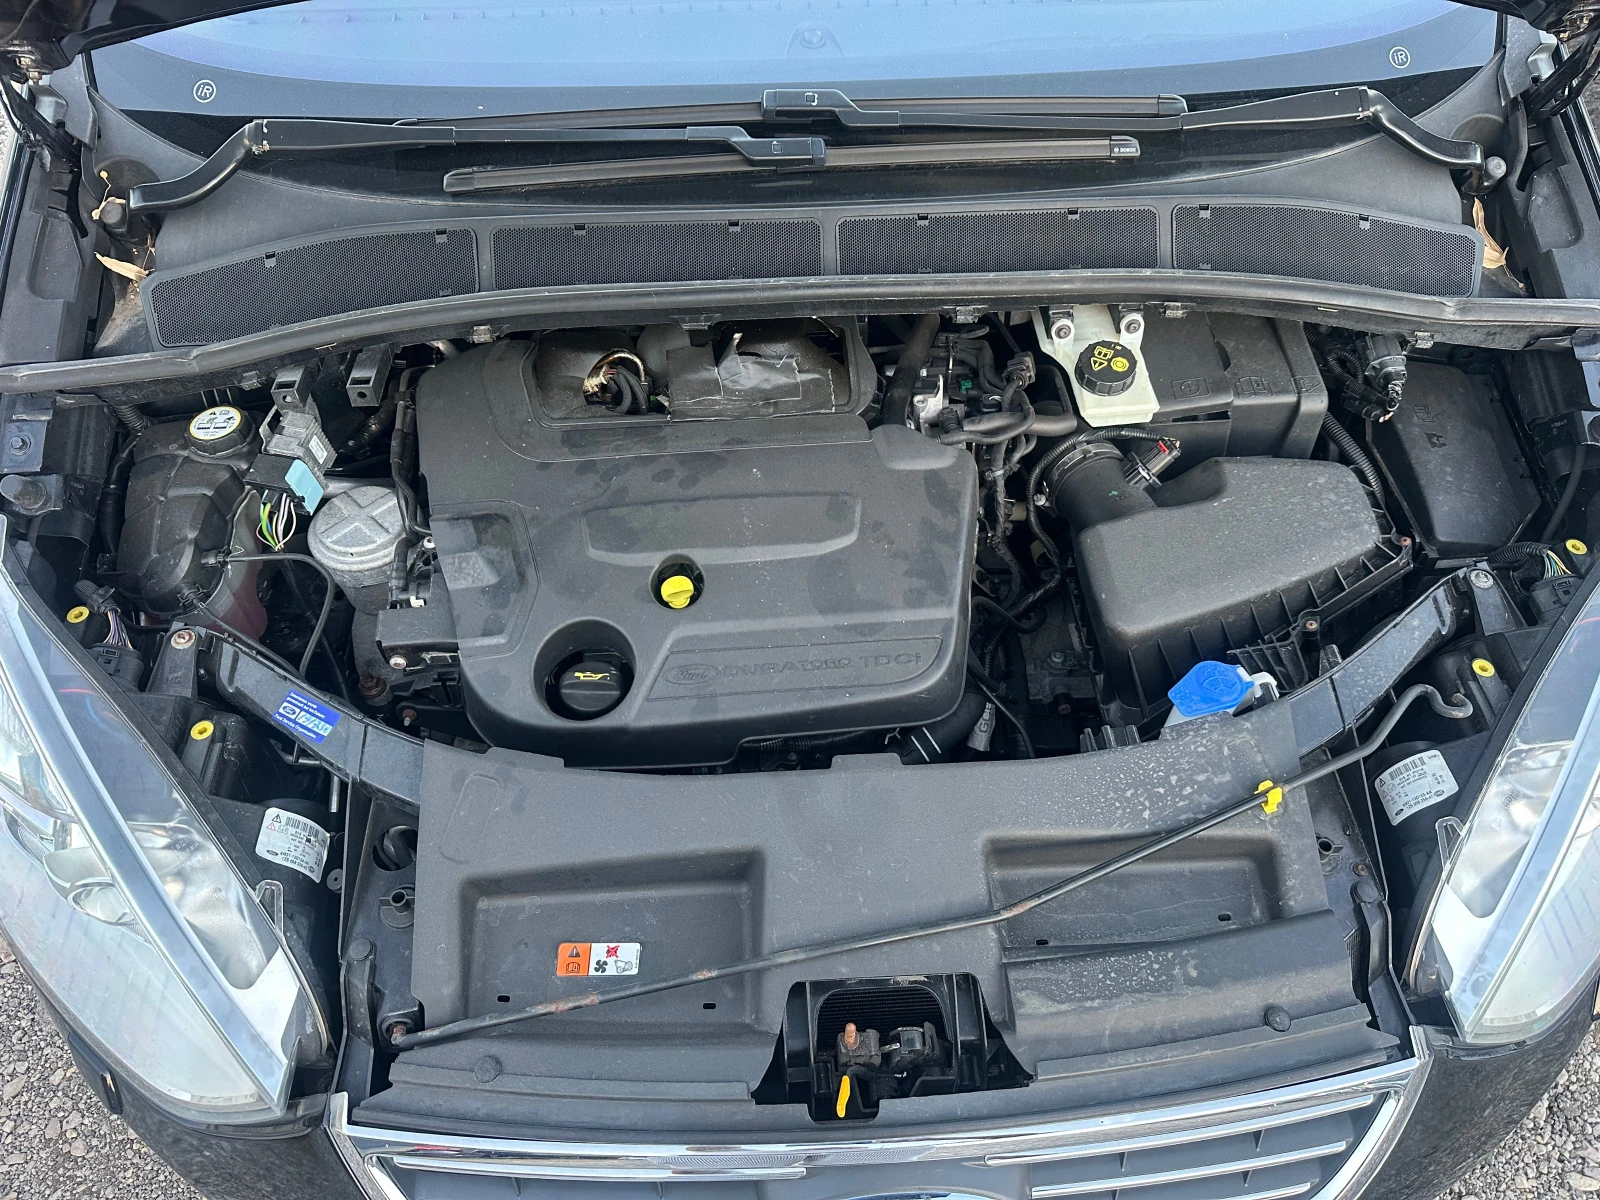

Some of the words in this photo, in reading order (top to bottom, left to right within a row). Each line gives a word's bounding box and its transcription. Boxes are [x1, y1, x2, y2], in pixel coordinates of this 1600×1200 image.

[1393, 51, 1407, 64] iR
[197, 84, 213, 98] iR
[860, 653, 923, 668] TDCi
